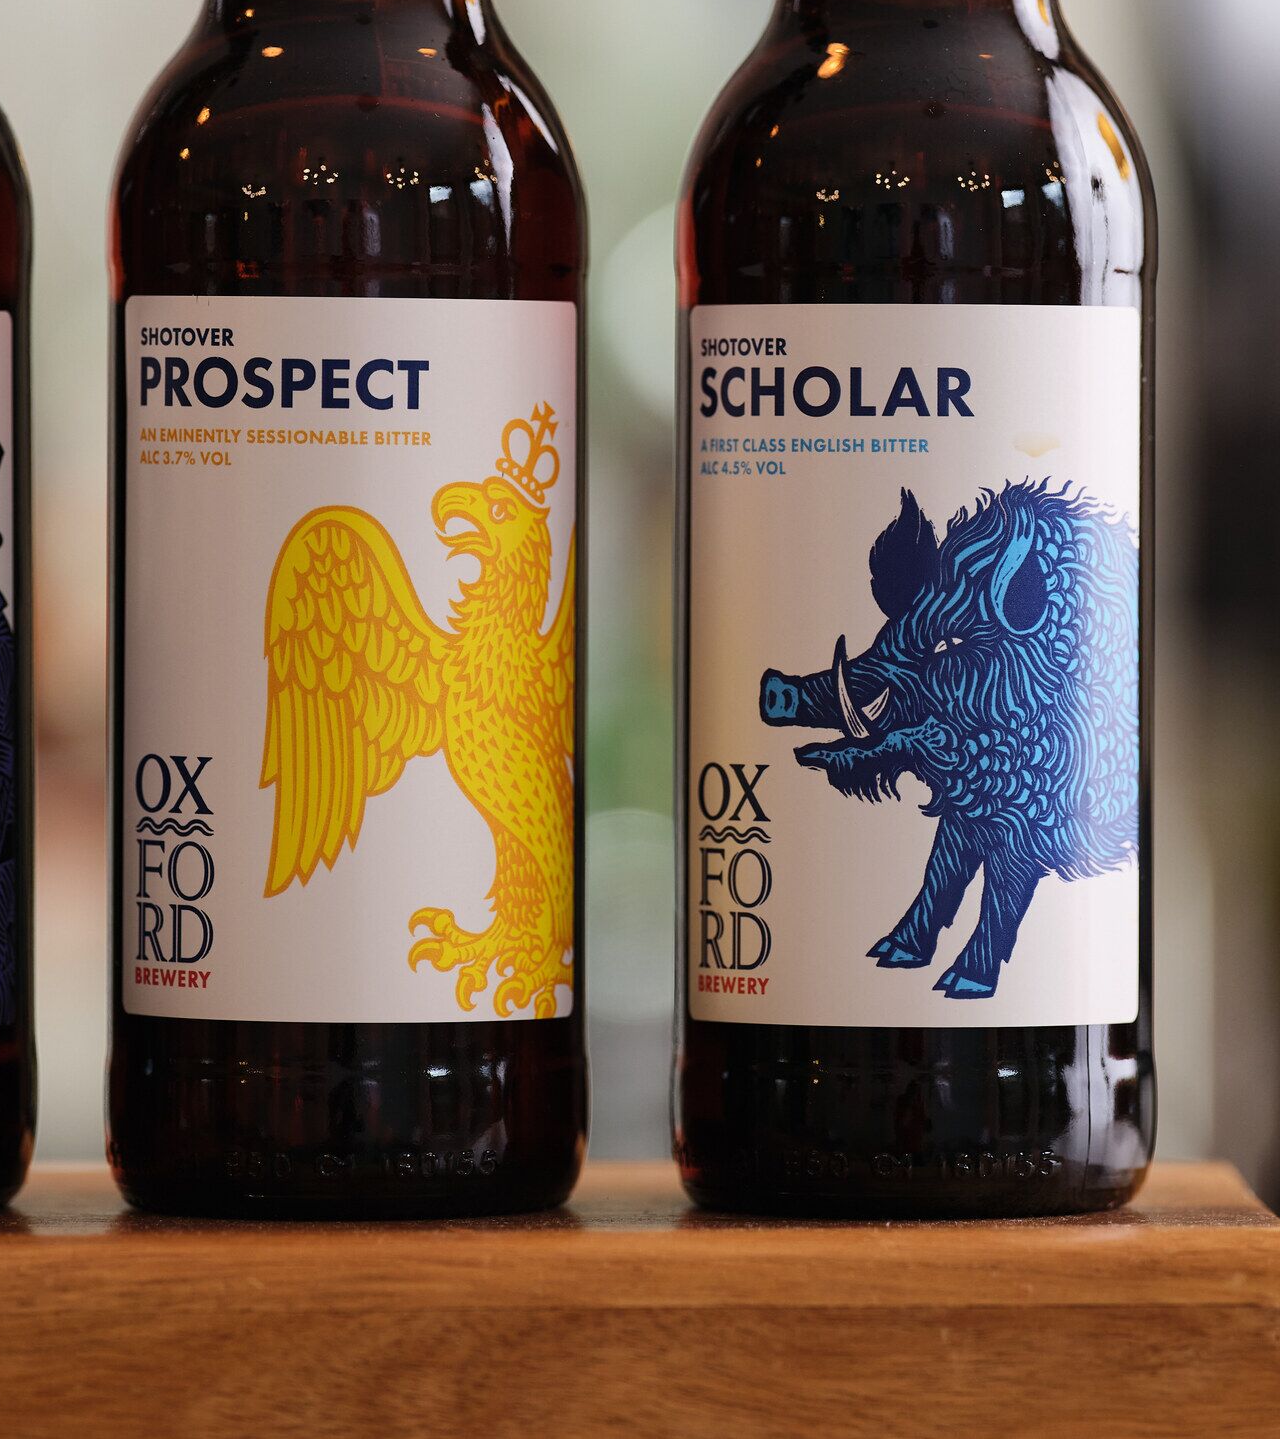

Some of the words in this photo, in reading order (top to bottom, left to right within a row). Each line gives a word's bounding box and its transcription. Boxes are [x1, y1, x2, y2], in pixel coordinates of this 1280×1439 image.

[141, 327, 234, 346] SHOTOVER
[701, 338, 787, 357] SHOTOVER
[140, 356, 430, 411] PROSPECT
[700, 366, 975, 418] SCHOLAR
[140, 428, 156, 441] AN
[160, 428, 241, 443] EMINENTLY
[247, 429, 367, 444] SESSIONABLE
[375, 431, 431, 445] BITTER
[709, 438, 739, 452] FIRST
[743, 438, 785, 452] CLASS
[792, 439, 864, 452] ENGLISH
[871, 439, 928, 452] BITTER
[140, 450, 160, 464] ALC
[163, 451, 195, 465] 3.7%
[200, 451, 231, 465] VOL
[700, 461, 718, 475] ALC
[721, 461, 751, 475] 4.5%
[756, 461, 786, 475] VOL
[135, 966, 211, 989] BREWERY
[698, 974, 769, 995] BREWERY
